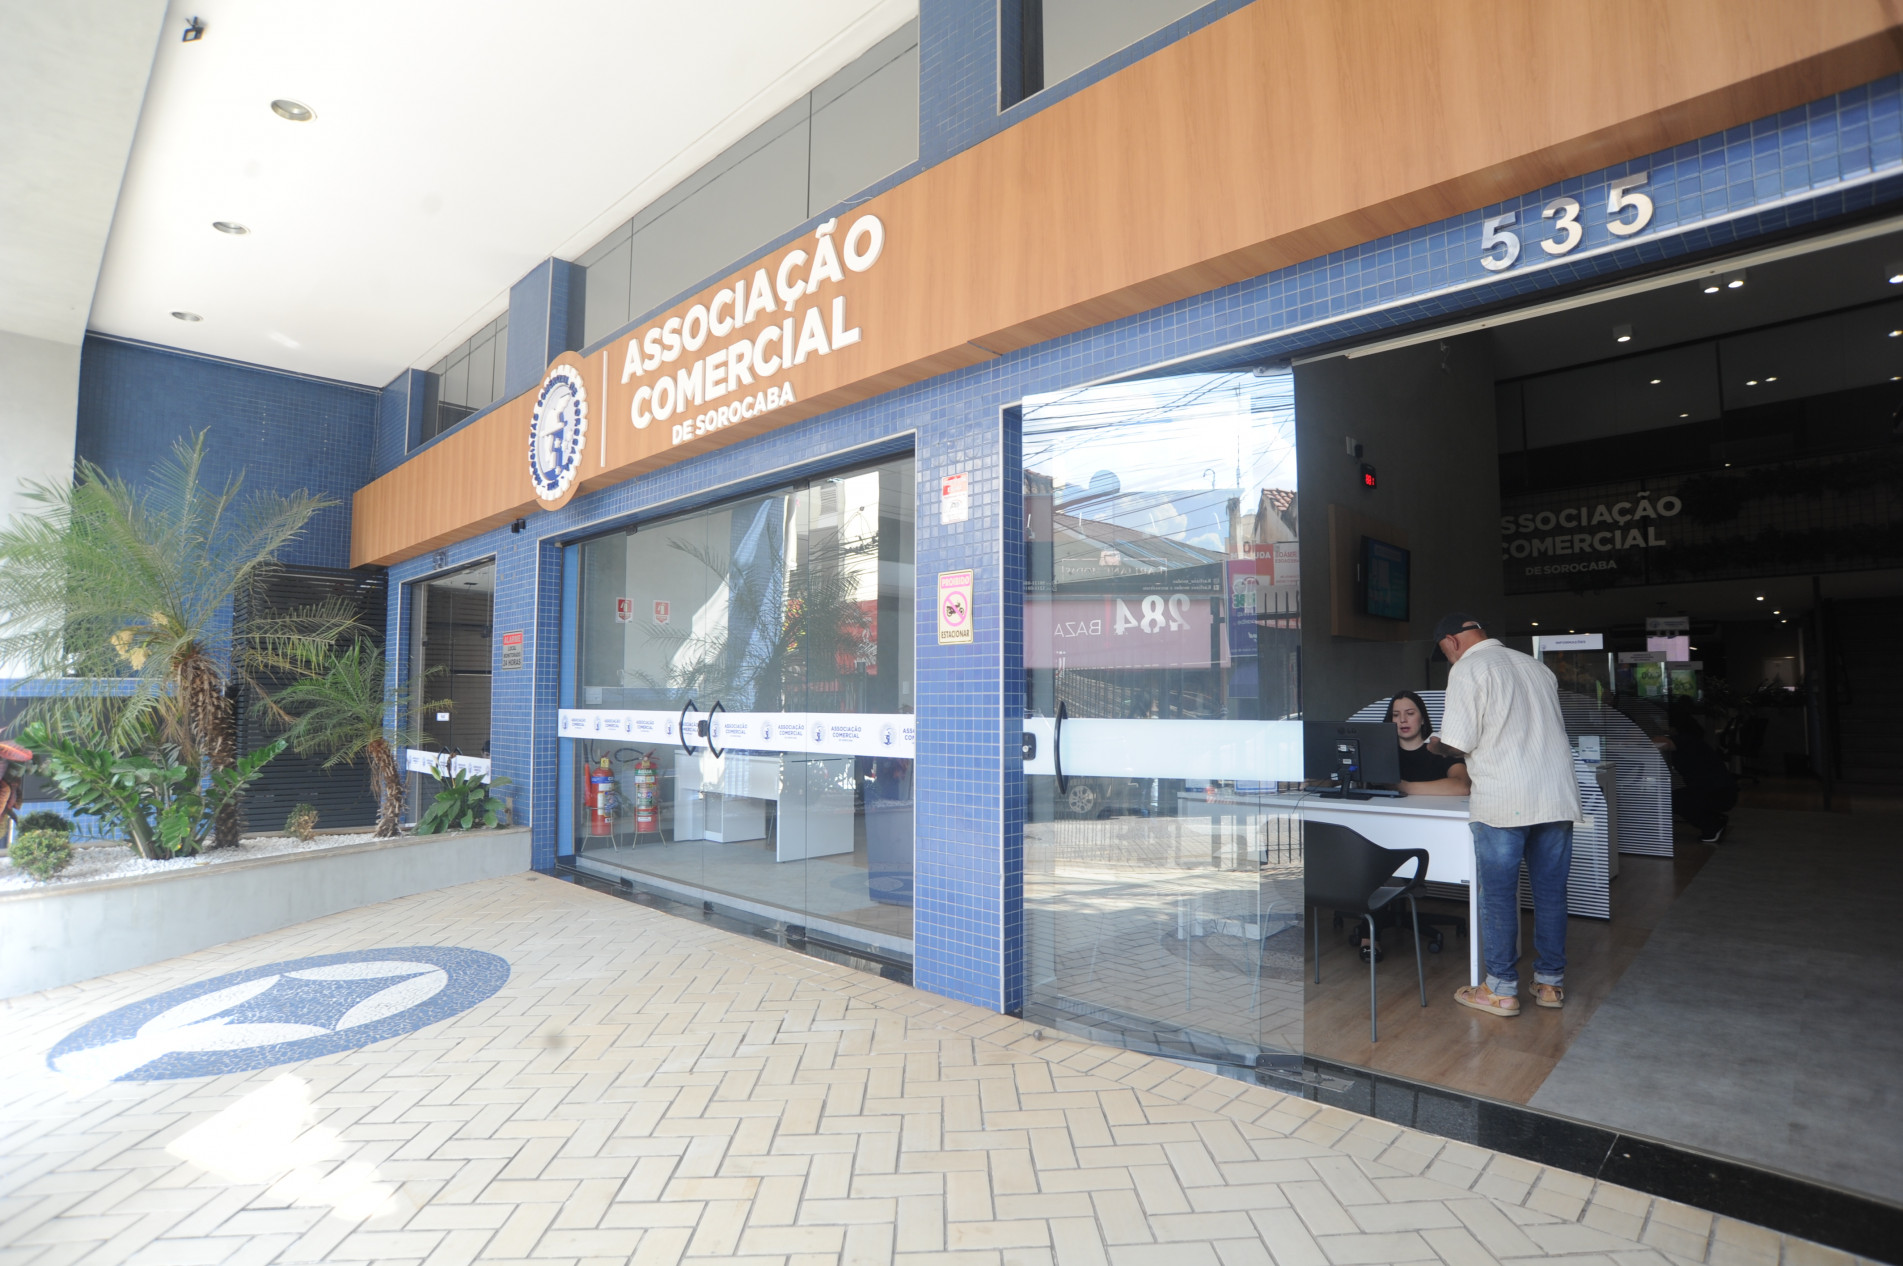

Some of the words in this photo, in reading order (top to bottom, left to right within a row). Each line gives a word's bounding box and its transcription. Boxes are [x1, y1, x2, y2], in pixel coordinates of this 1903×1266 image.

[1480, 171, 1653, 271] 535
[621, 213, 885, 385] ASSOCIAÇÃO
[630, 295, 862, 430] COMERCIAL
[671, 418, 695, 446] DE
[697, 380, 798, 437] SOROCABA
[1500, 490, 1683, 535] SSOCIAÇÃO
[941, 575, 970, 587] PROIBIDO
[1525, 565, 1543, 576] DE
[1543, 559, 1618, 575] SOROCABA
[941, 629, 970, 640] ESTACIONAR
